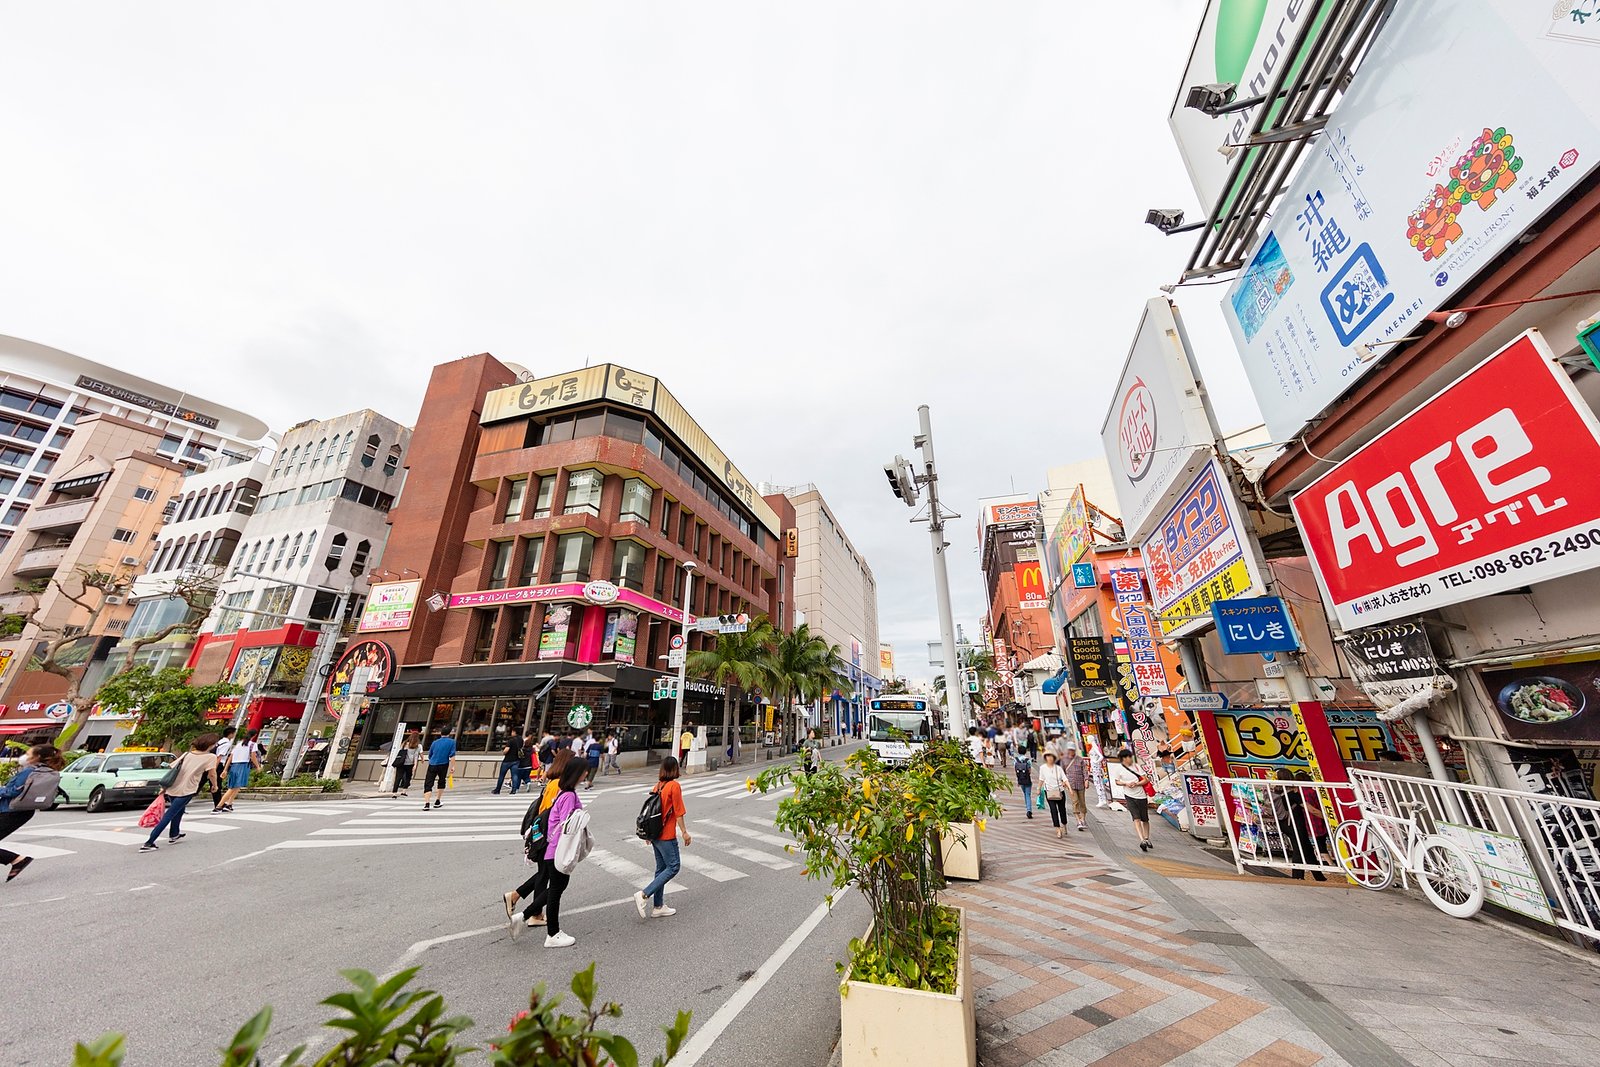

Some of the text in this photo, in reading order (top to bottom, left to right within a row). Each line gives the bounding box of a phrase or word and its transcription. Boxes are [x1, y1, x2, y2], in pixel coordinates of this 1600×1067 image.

[1526, 166, 1560, 199] 福太郎
[1296, 190, 1350, 273] 沖縄
[1448, 237, 1481, 271] RYUKYU
[1484, 204, 1515, 237] FRONT
[1341, 338, 1382, 377] OKINWA
[1385, 298, 1424, 336] MENBEI
[519, 377, 578, 410] 白木屋
[615, 368, 649, 406] 白木屋
[1324, 407, 1551, 570] Agre
[1166, 478, 1217, 552] ダイコク
[1450, 494, 1568, 545] アグレ
[1075, 567, 1086, 584] 水着
[1187, 539, 1236, 582] 免税 Tax-Free
[1114, 571, 1141, 591] 薬
[1119, 594, 1143, 603] ダイコク
[1221, 605, 1280, 616] スキンケアハウス
[1229, 621, 1286, 641] にしき
[1074, 653, 1102, 661] Design
[1364, 641, 1405, 660] にしき
[1135, 664, 1164, 680] 免税
[1215, 716, 1309, 758] 13%
[1331, 728, 1384, 761] FF
[1192, 806, 1216, 815] 免税
